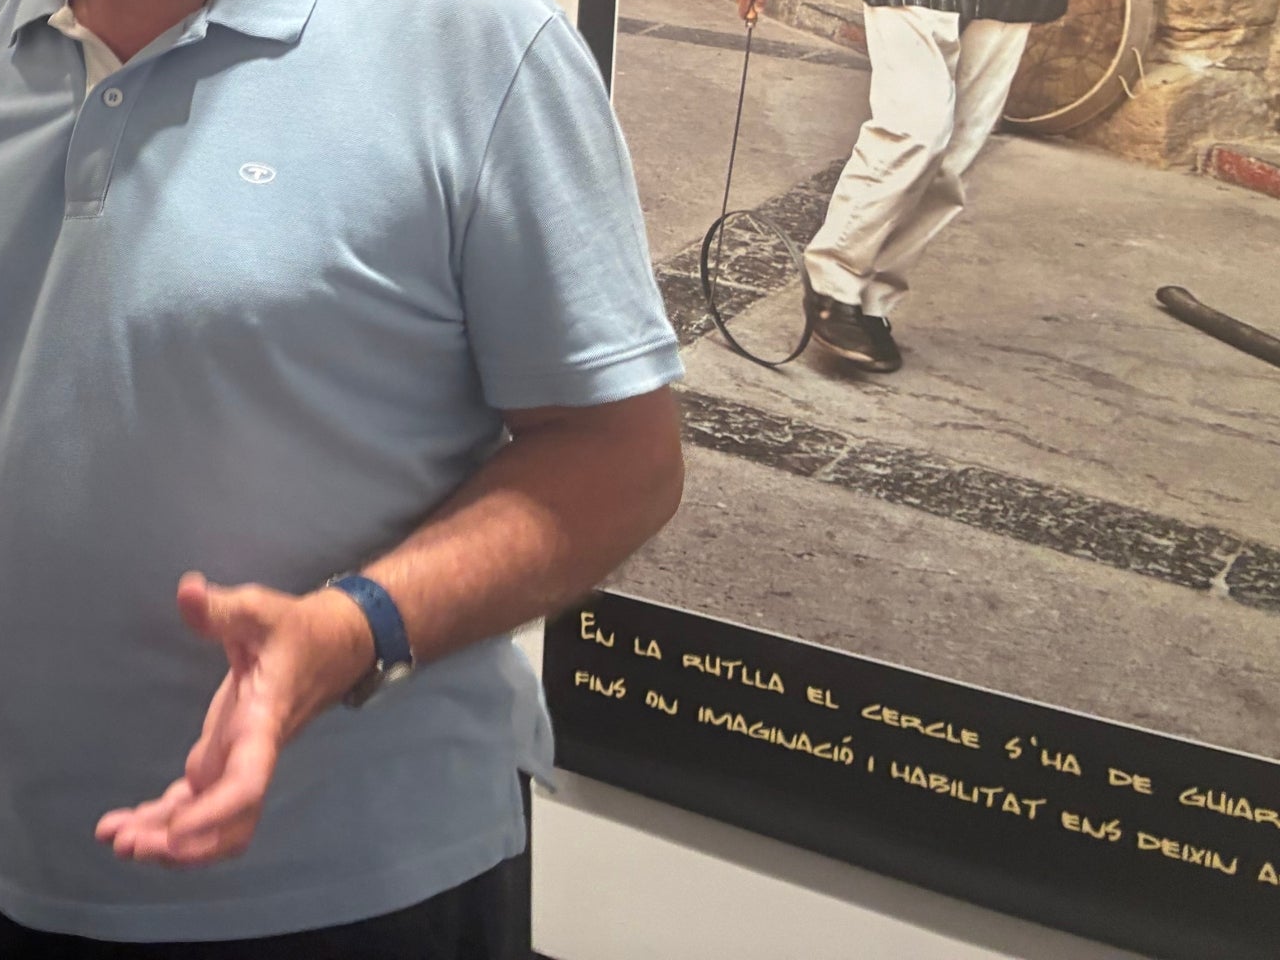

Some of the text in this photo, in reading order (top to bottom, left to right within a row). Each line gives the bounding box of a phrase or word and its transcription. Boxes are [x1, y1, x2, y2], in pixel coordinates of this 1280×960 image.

[574, 670, 1280, 886] FINS ON IMAGINACIÓ I HABILITAT ENS DEIXIN A
[580, 611, 615, 647] EN
[633, 636, 662, 660] LA
[682, 653, 785, 694] RUTLLA
[806, 686, 839, 709] EL
[861, 704, 981, 749] CERCLE
[1004, 736, 1082, 776] S'HA
[1108, 767, 1153, 795] DE
